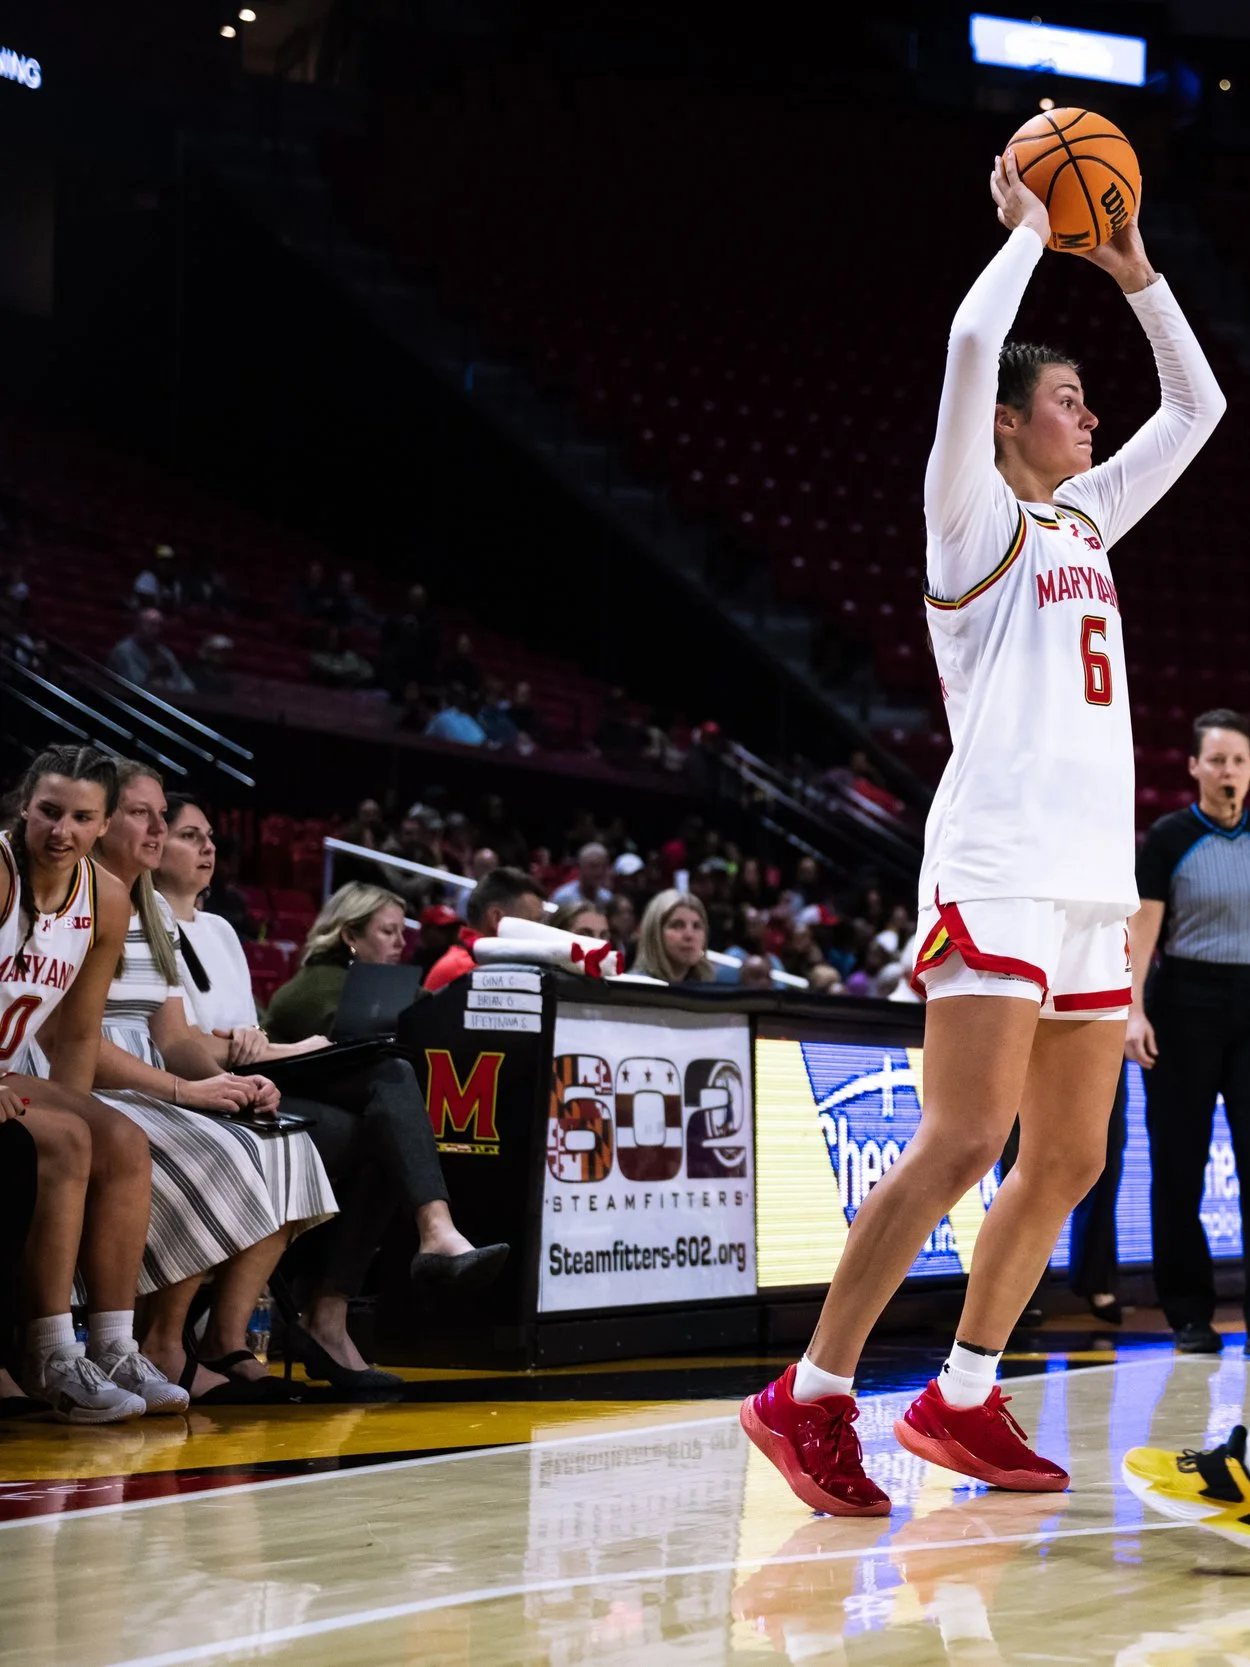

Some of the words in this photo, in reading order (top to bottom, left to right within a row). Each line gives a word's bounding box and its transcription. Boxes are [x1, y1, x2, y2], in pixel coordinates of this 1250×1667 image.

[1080, 614, 1113, 706] 6
[477, 994, 502, 1007] BRIAN
[425, 1048, 505, 1141] M
[547, 1053, 748, 1184] 602
[552, 1192, 744, 1214] STEAMFITTERS
[549, 1235, 746, 1276] Steamfitters-602.org
